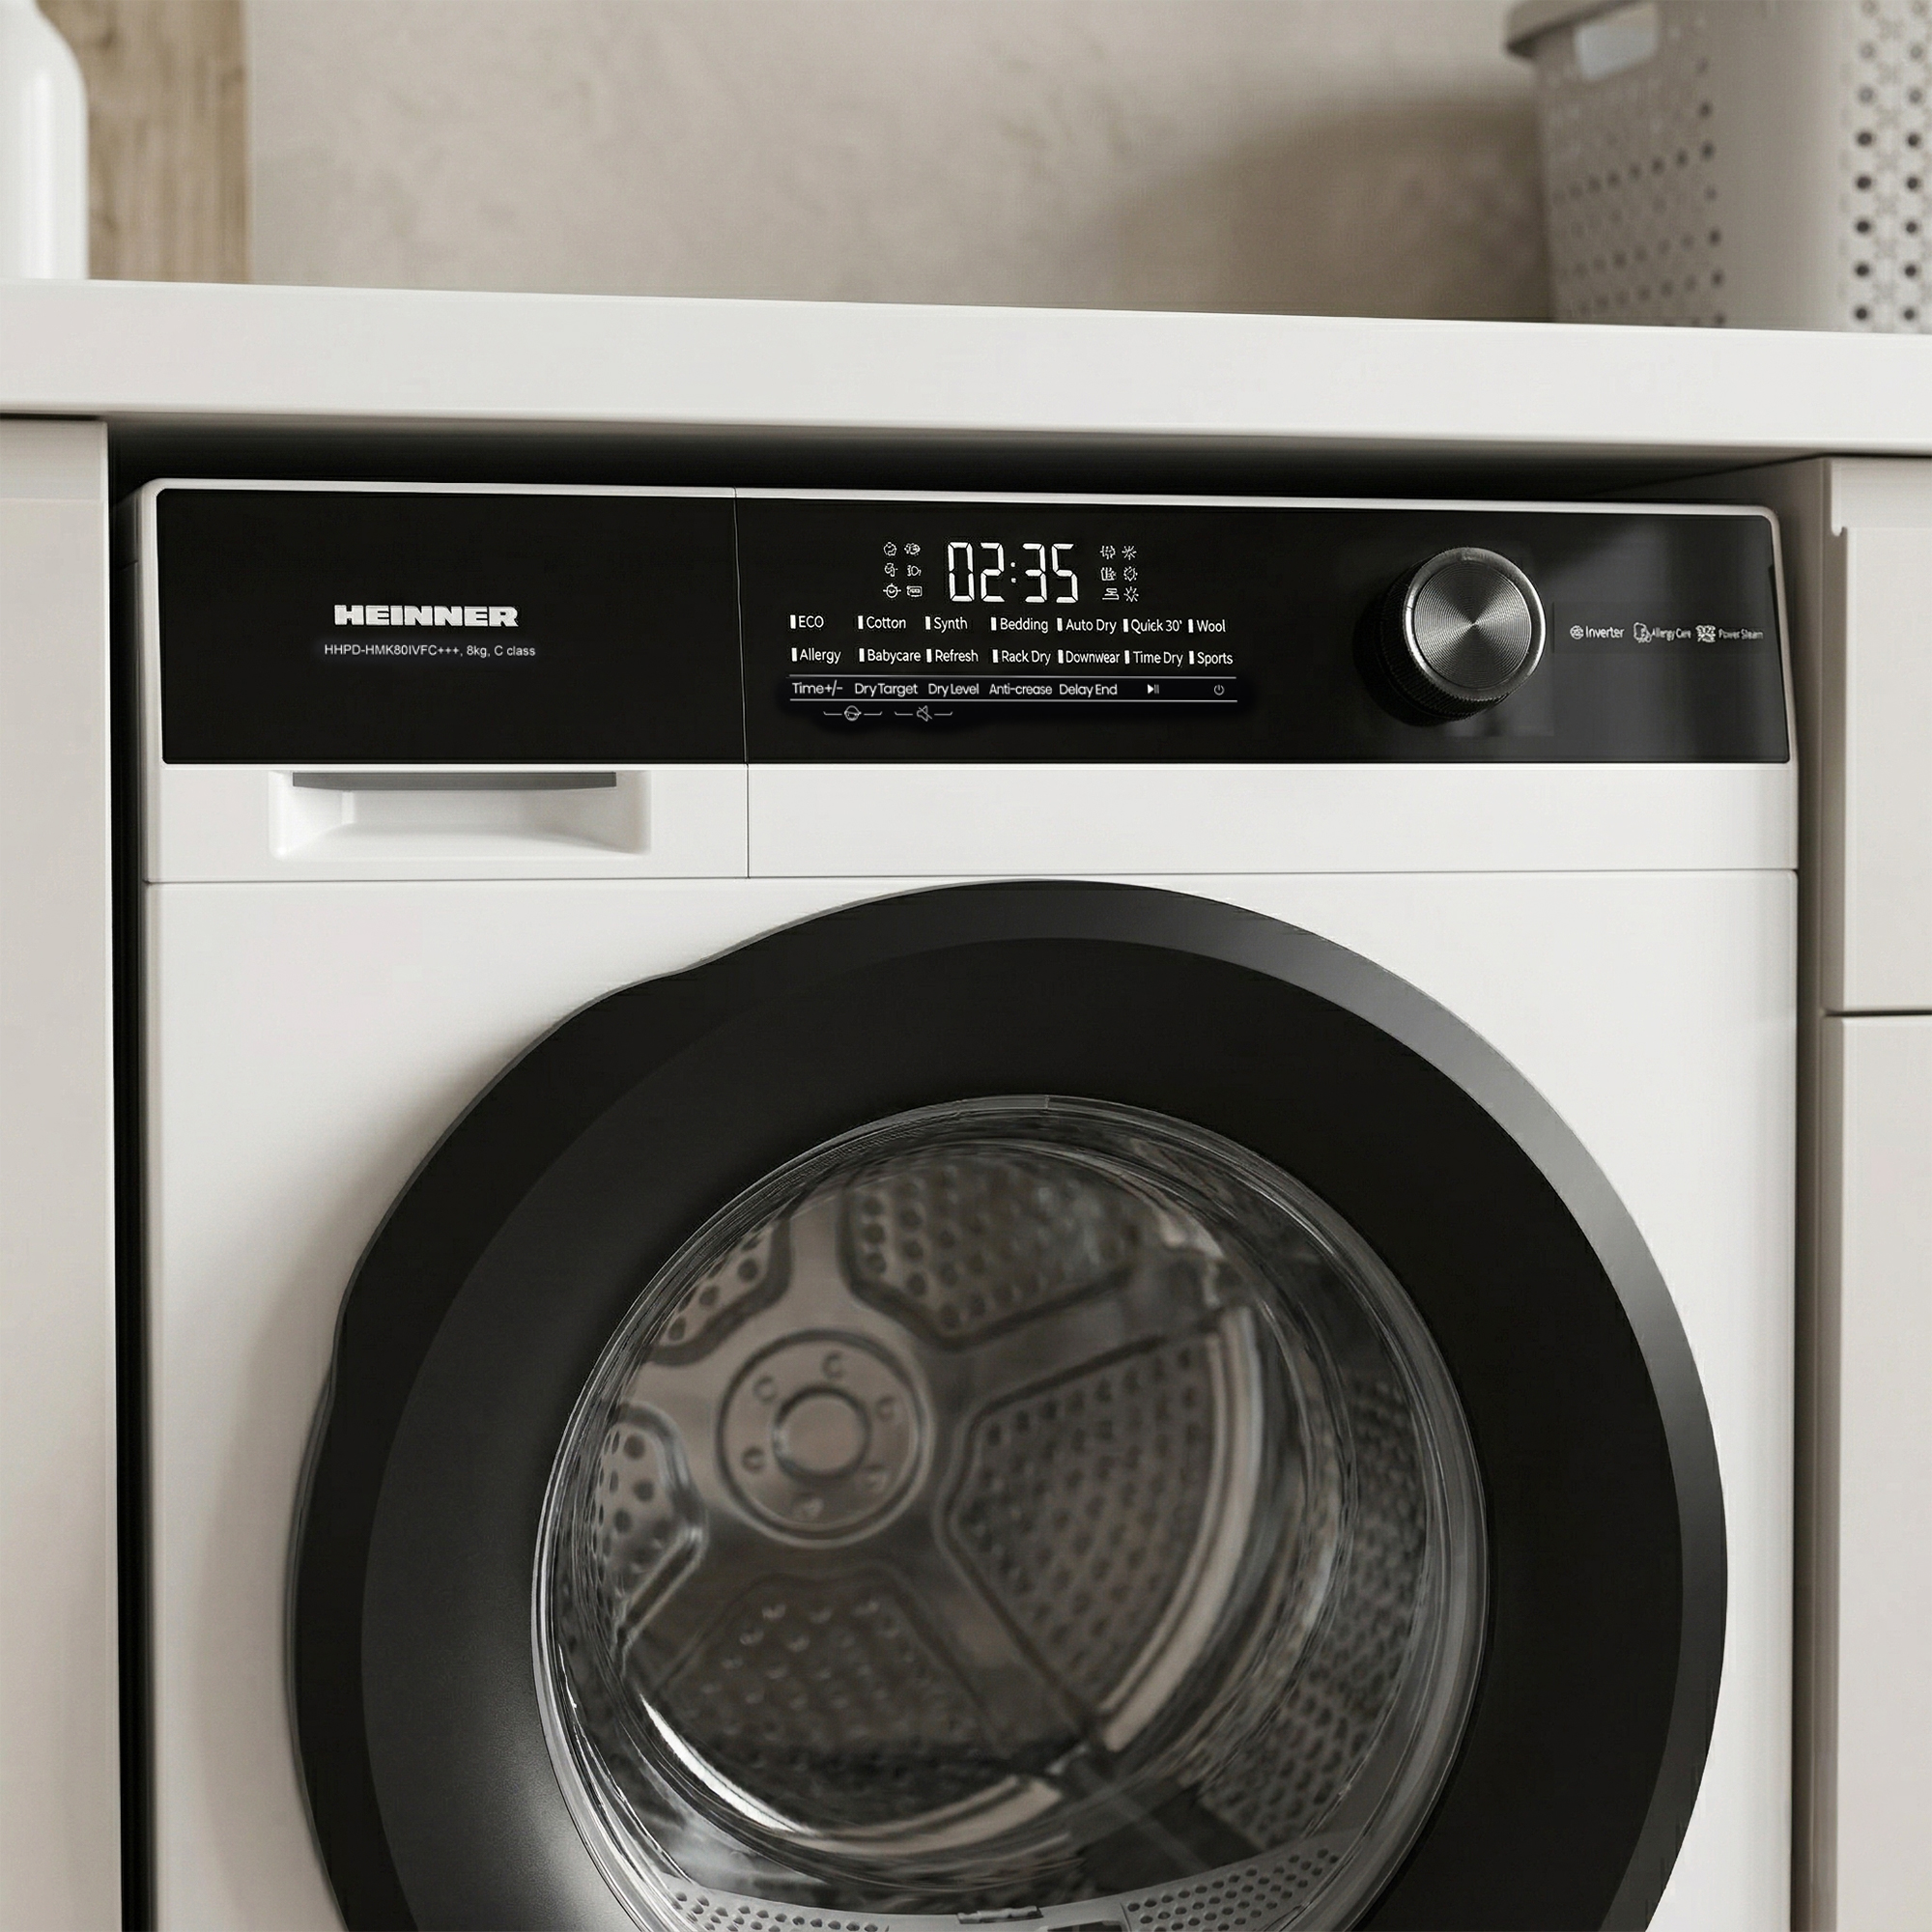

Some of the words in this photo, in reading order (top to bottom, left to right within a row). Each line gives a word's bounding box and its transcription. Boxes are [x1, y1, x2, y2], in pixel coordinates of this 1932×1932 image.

[948, 542, 1079, 604] 02:35
[334, 604, 519, 627] HEINNER
[799, 615, 825, 628] ECO
[867, 616, 907, 629] Cotton
[934, 617, 968, 633] Synth
[1001, 617, 1049, 633] Bedding
[1066, 619, 1094, 632] Auto
[1096, 619, 1118, 634] Dry
[1131, 619, 1164, 634] Quick
[1197, 619, 1226, 633] Wool
[1586, 625, 1625, 639] Inverter
[325, 644, 463, 657] HHPD-HMK80IVFC+++,
[467, 644, 491, 659] 8kg,
[494, 644, 503, 657] C
[507, 644, 536, 657] class
[800, 648, 841, 664] Allergy
[867, 648, 922, 664] Babycare
[935, 649, 979, 663] Refresh
[1002, 650, 1030, 663] Rack
[1032, 650, 1052, 665] Dry
[1066, 651, 1121, 664] Downwear
[1133, 651, 1162, 664] Time
[1164, 651, 1183, 667] Dry
[1198, 652, 1234, 667] Sports
[792, 680, 843, 696] Time+/-
[989, 682, 1053, 696] Anti-crease
[1060, 683, 1094, 697] Delay
[1095, 683, 1118, 696] End
